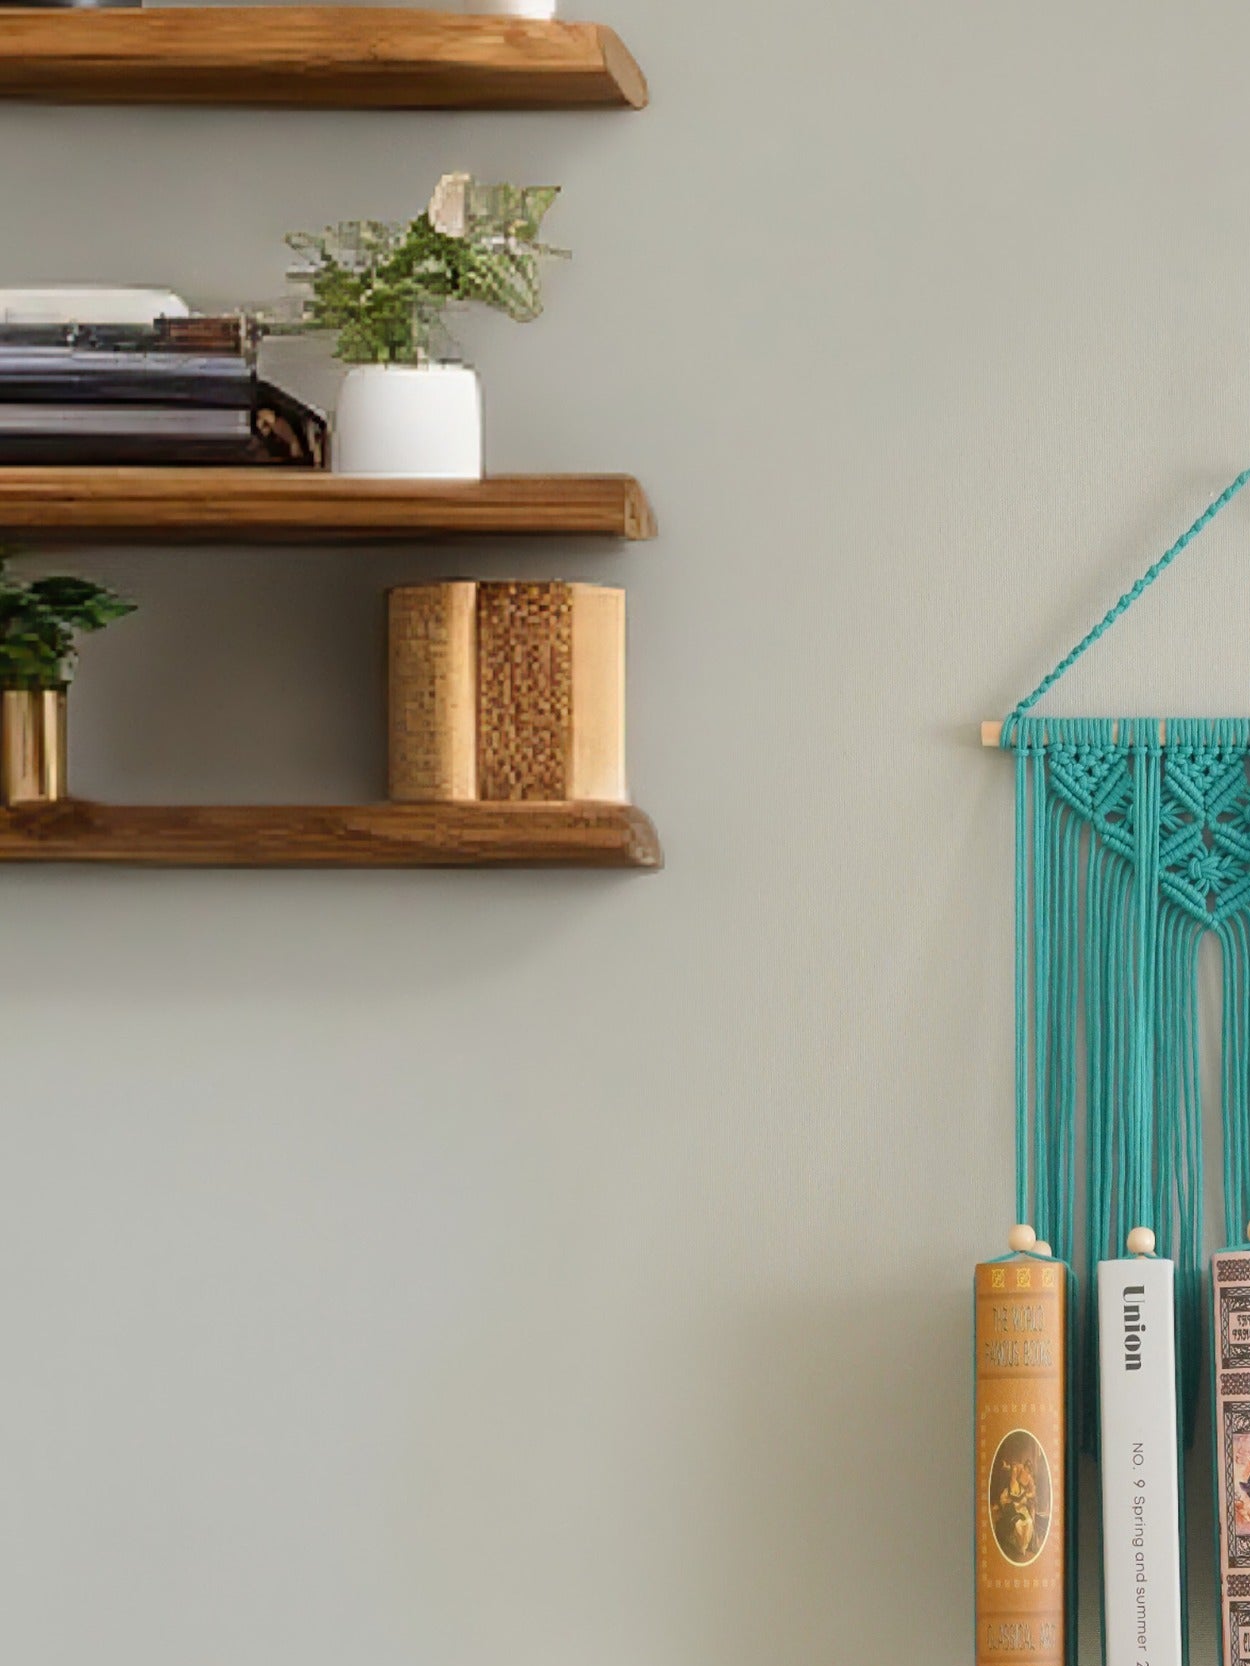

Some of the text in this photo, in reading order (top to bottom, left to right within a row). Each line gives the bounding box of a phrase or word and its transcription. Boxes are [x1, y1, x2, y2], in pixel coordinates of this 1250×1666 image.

[1122, 1285, 1146, 1371] Union
[1132, 1442, 1144, 1470] NO.
[1133, 1479, 1146, 1488] 9
[1132, 1496, 1146, 1547] Spring
[1135, 1552, 1147, 1583] and
[1136, 1587, 1147, 1652] summer
